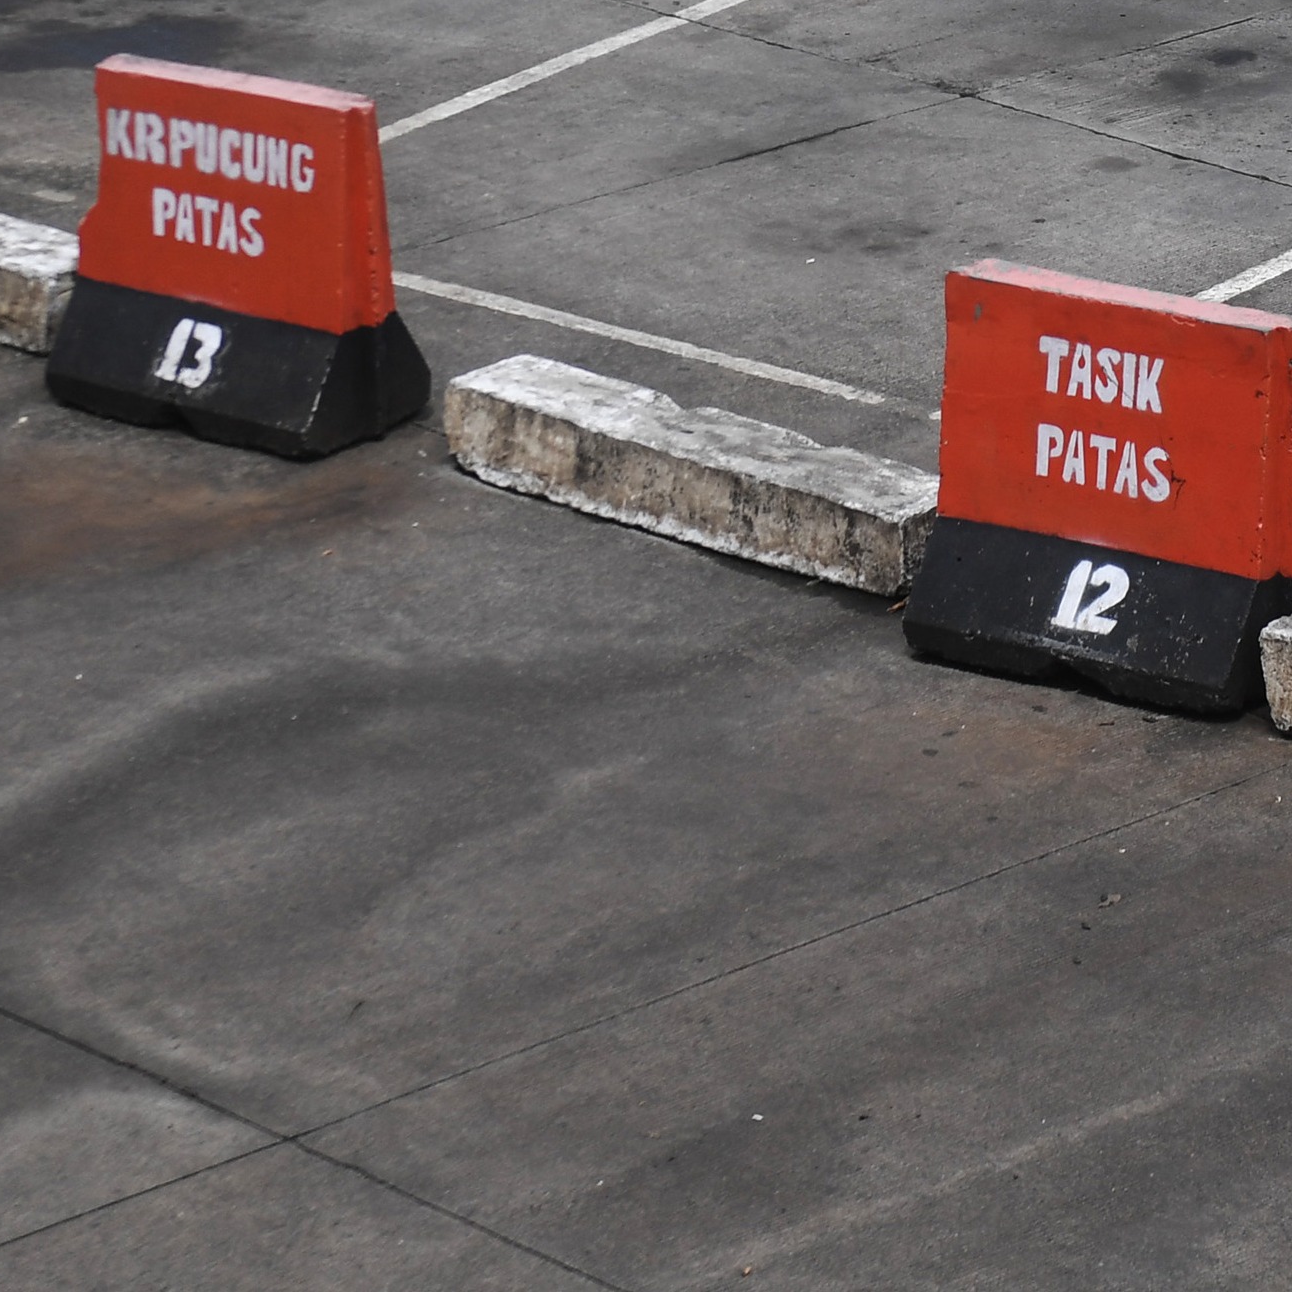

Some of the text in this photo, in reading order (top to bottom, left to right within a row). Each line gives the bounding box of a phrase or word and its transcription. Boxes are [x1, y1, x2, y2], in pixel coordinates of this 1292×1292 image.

[151, 186, 265, 257] PATAS
[154, 317, 223, 389] 13
[1038, 334, 1165, 414] TASIK
[1035, 422, 1171, 503] PATAS
[1050, 559, 1130, 635] 12
